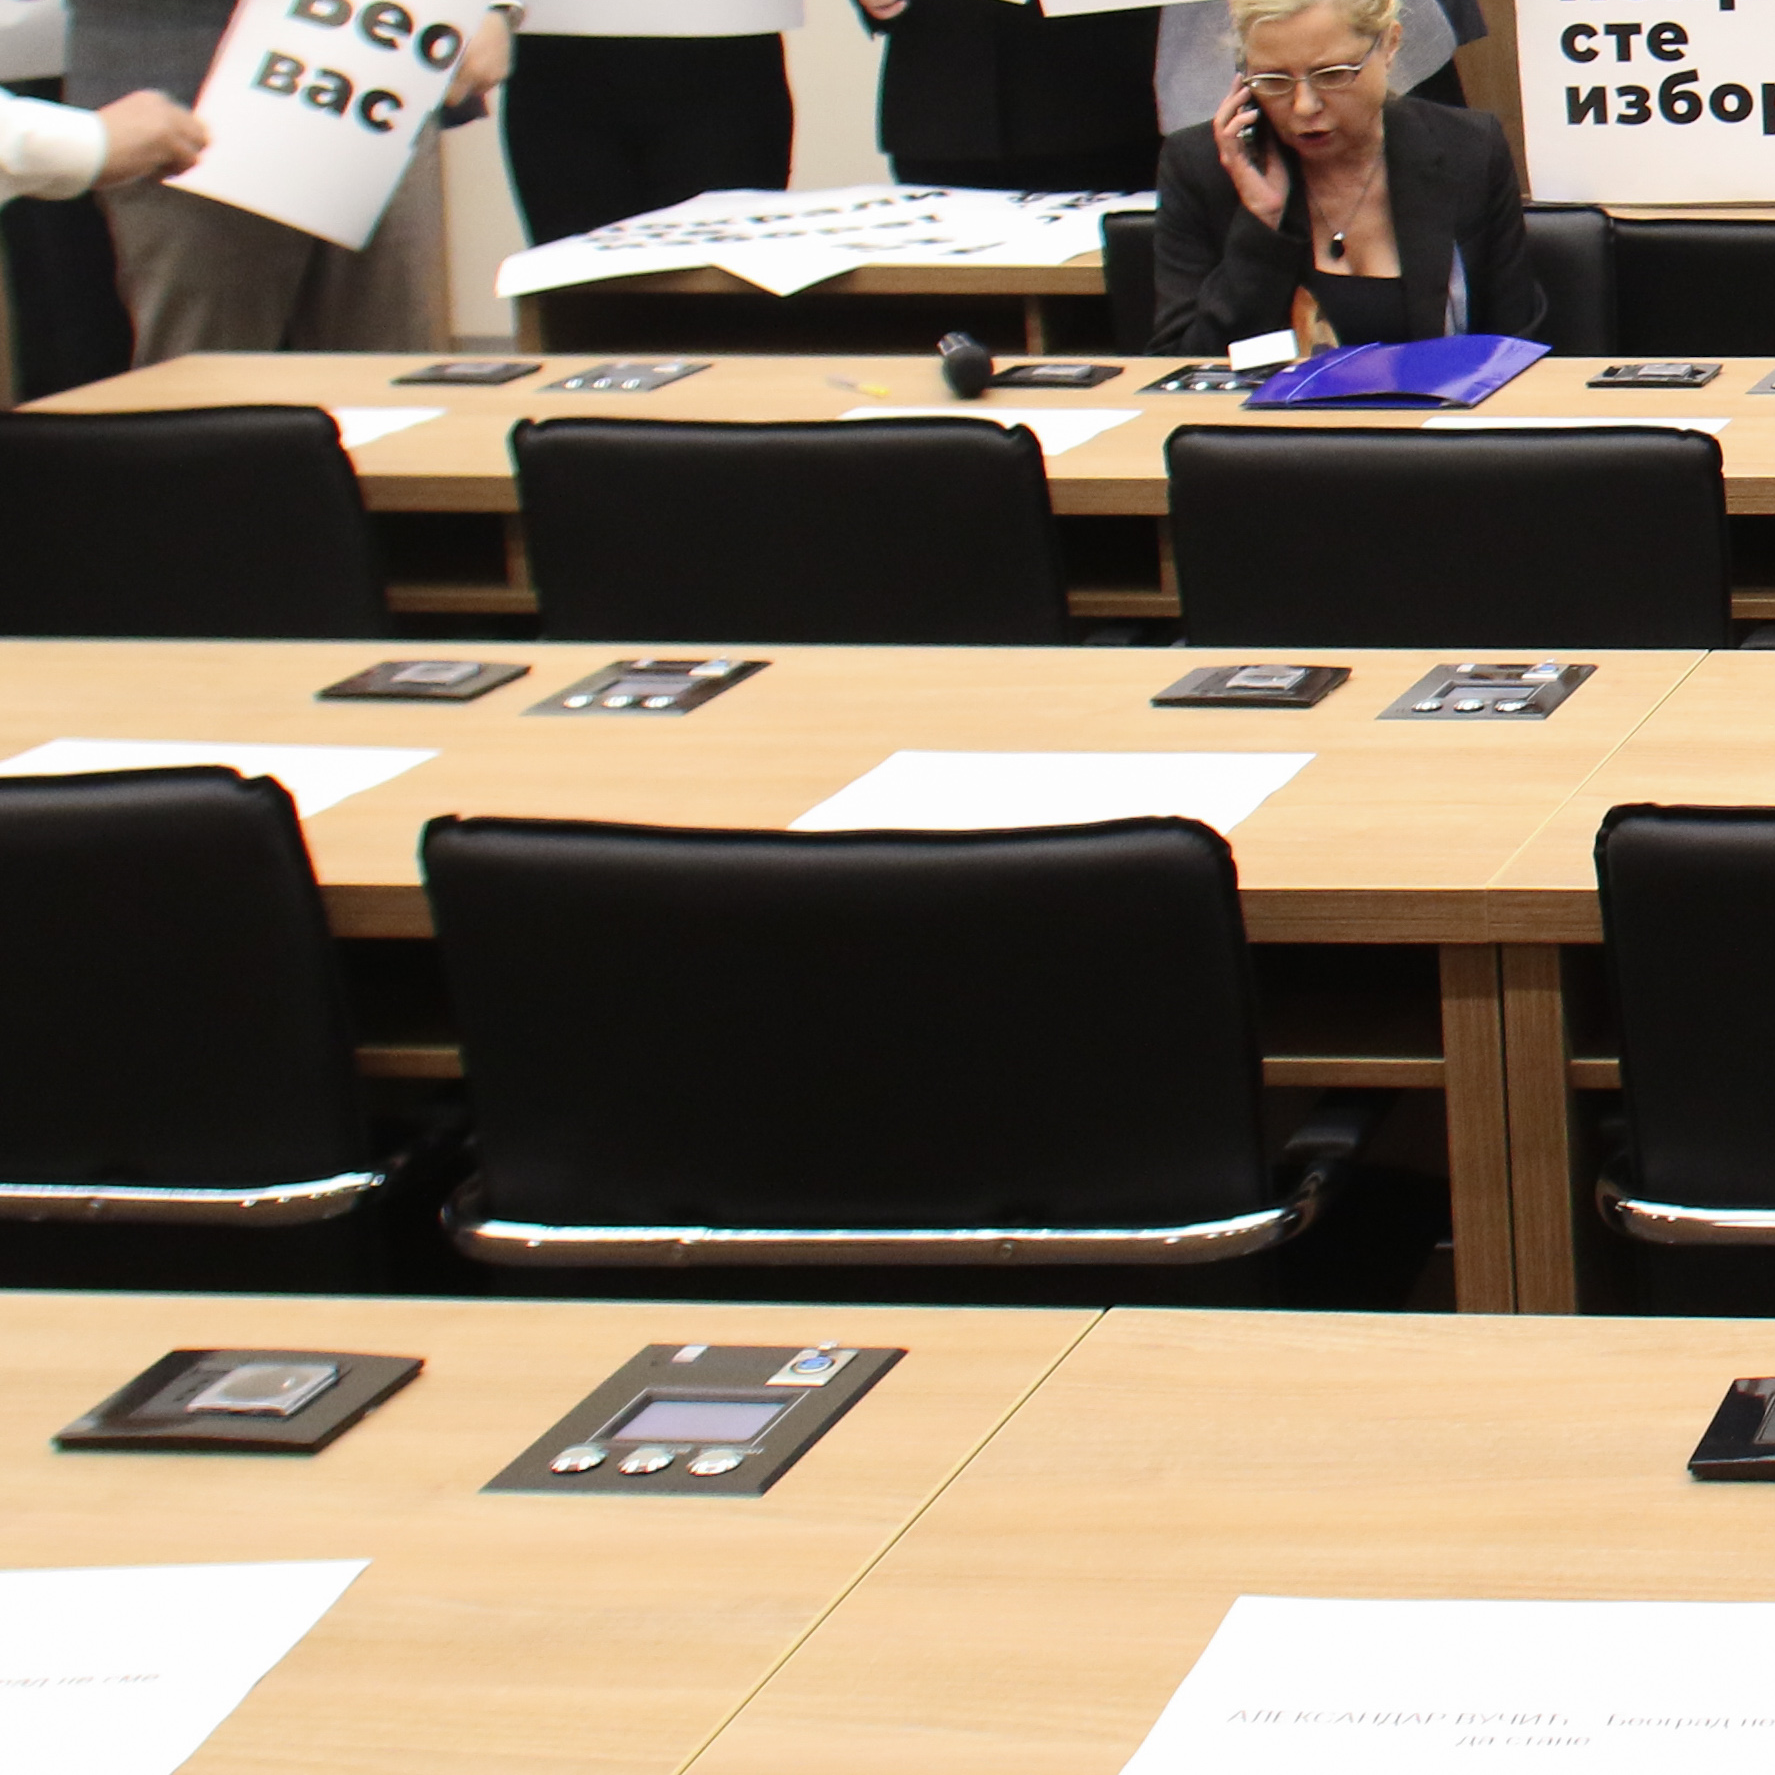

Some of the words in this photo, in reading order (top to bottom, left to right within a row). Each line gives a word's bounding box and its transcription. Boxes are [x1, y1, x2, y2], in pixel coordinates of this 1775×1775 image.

[1561, 22, 1688, 63] сте
[252, 52, 404, 135] вас
[1226, 1710, 1446, 1725] АЛЕКСАНДАР
